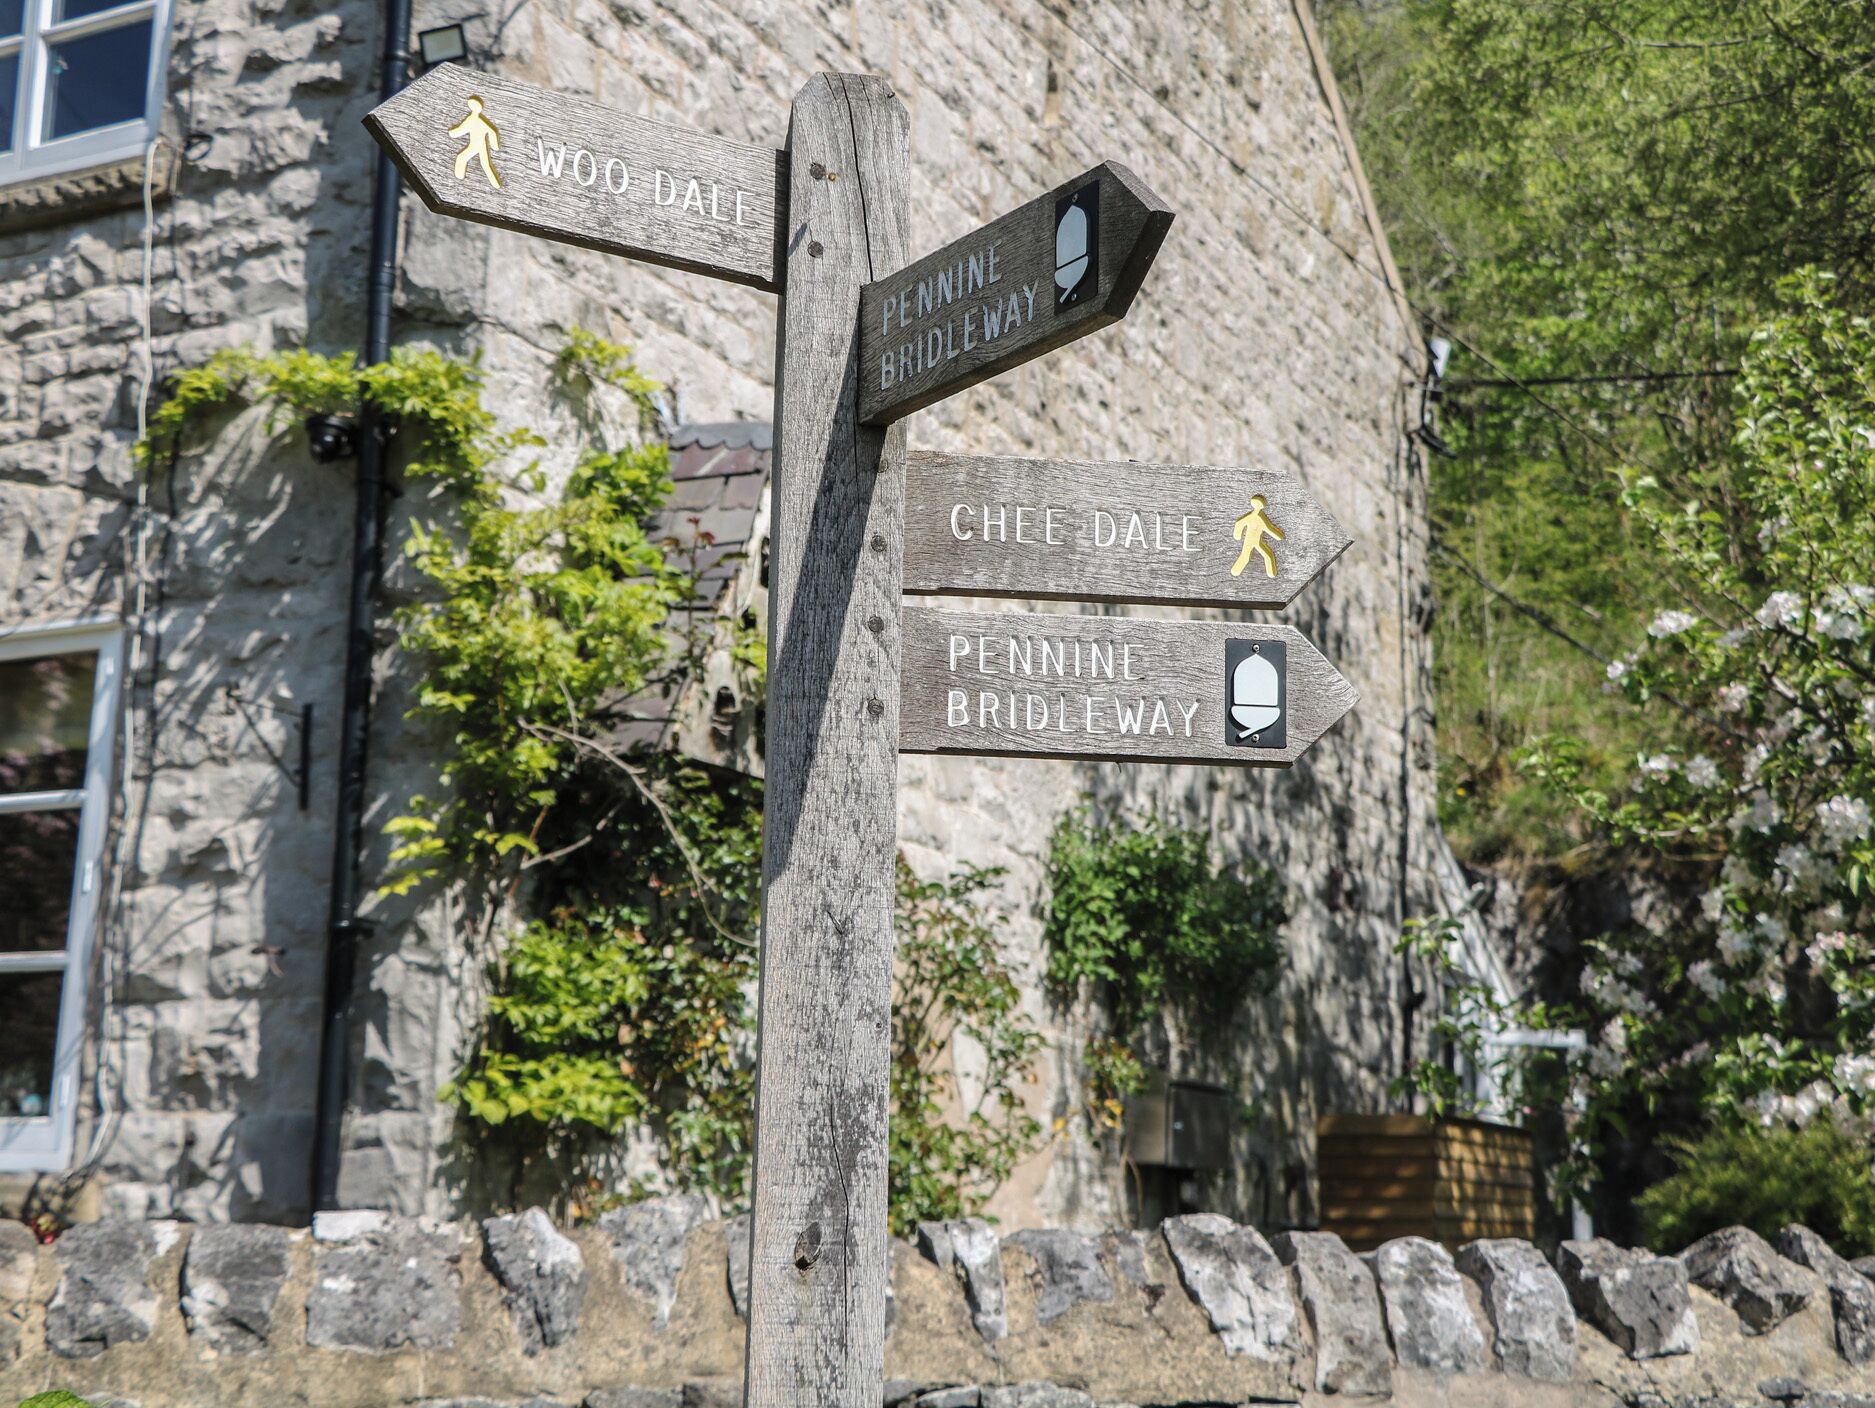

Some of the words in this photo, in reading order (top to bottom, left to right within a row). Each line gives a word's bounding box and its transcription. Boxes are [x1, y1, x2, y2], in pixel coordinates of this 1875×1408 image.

[537, 136, 630, 195] WOO
[654, 169, 755, 226] DALE
[883, 240, 1003, 336] PENNINE
[881, 278, 1039, 391] BRIDLEWAY
[950, 503, 1066, 545] CHEE
[1094, 509, 1204, 552] DALE
[949, 634, 1145, 681] PENNINE
[947, 689, 1201, 738] BRIDLEWAY
